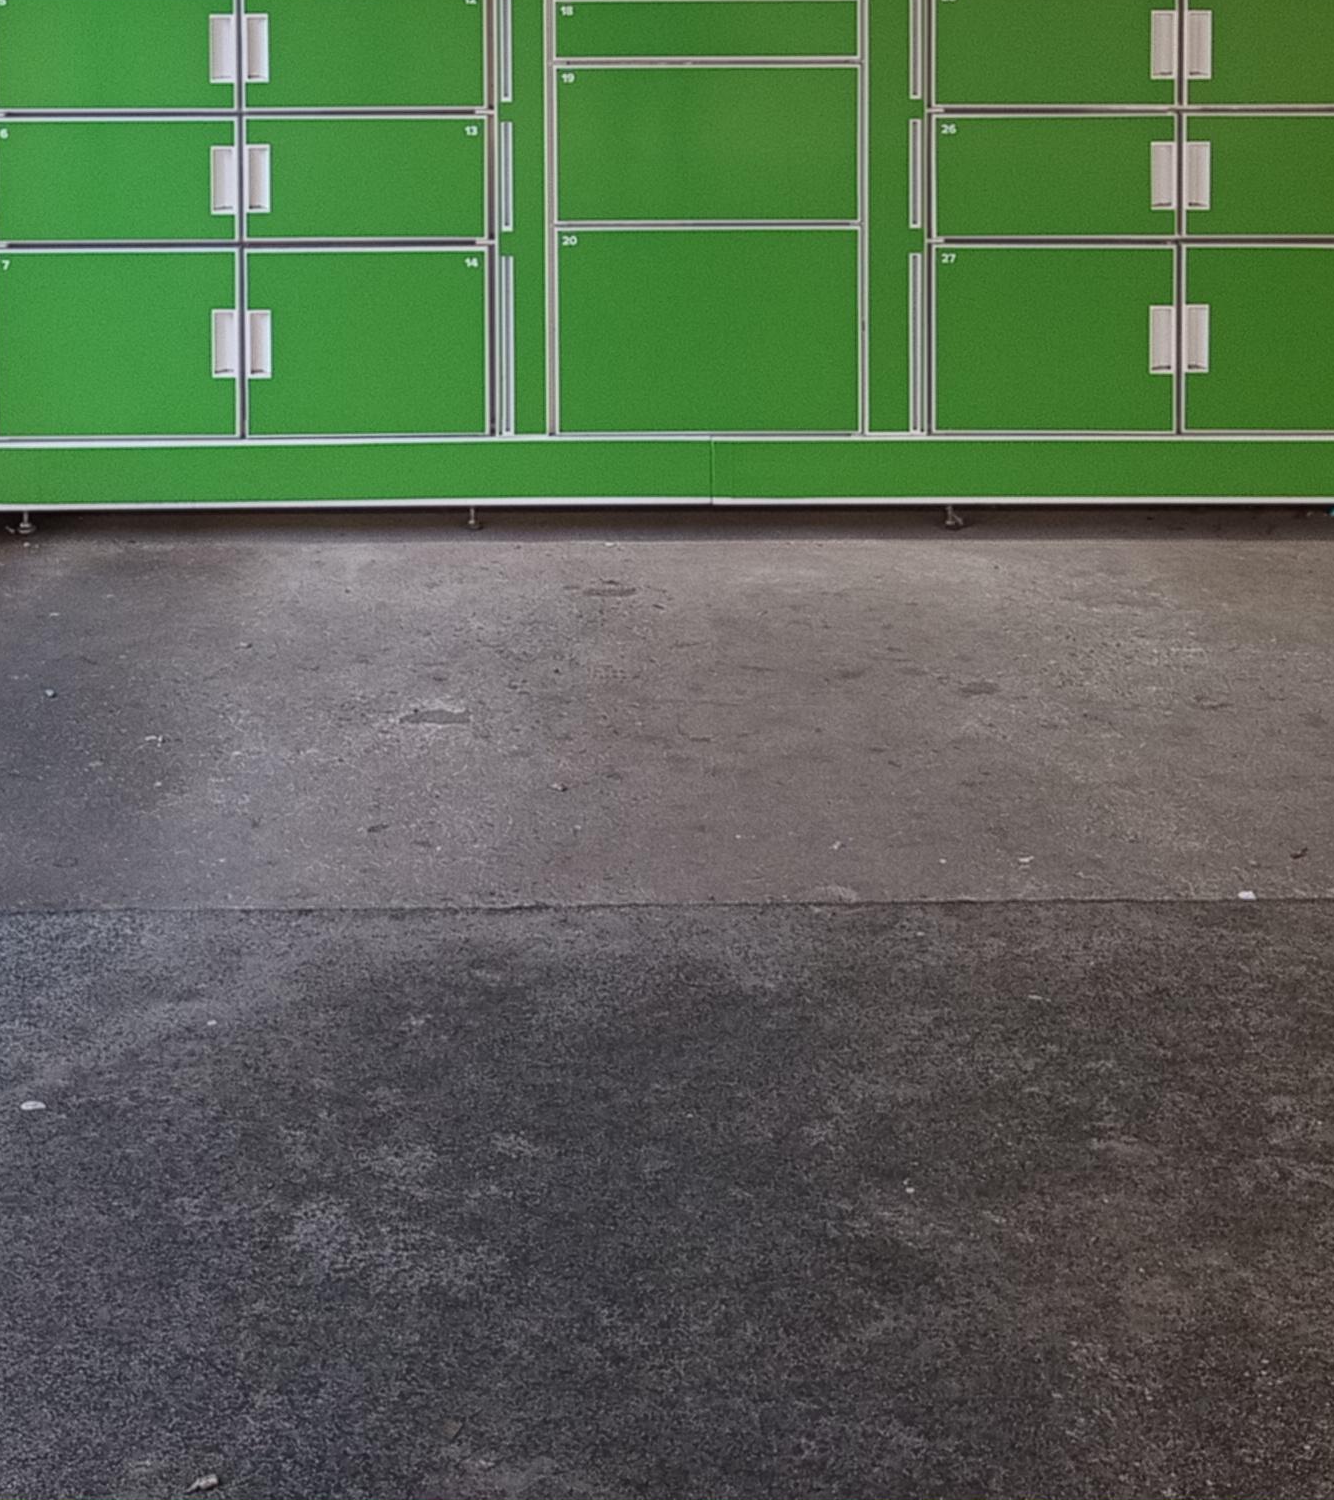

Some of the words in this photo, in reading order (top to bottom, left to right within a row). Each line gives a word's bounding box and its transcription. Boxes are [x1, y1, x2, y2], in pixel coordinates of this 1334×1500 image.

[560, 5, 574, 16] 18
[561, 72, 575, 83] 19
[464, 125, 478, 136] 13
[941, 123, 957, 134] 26
[561, 235, 578, 246] 20
[464, 257, 479, 268] 14
[941, 252, 957, 264] 27
